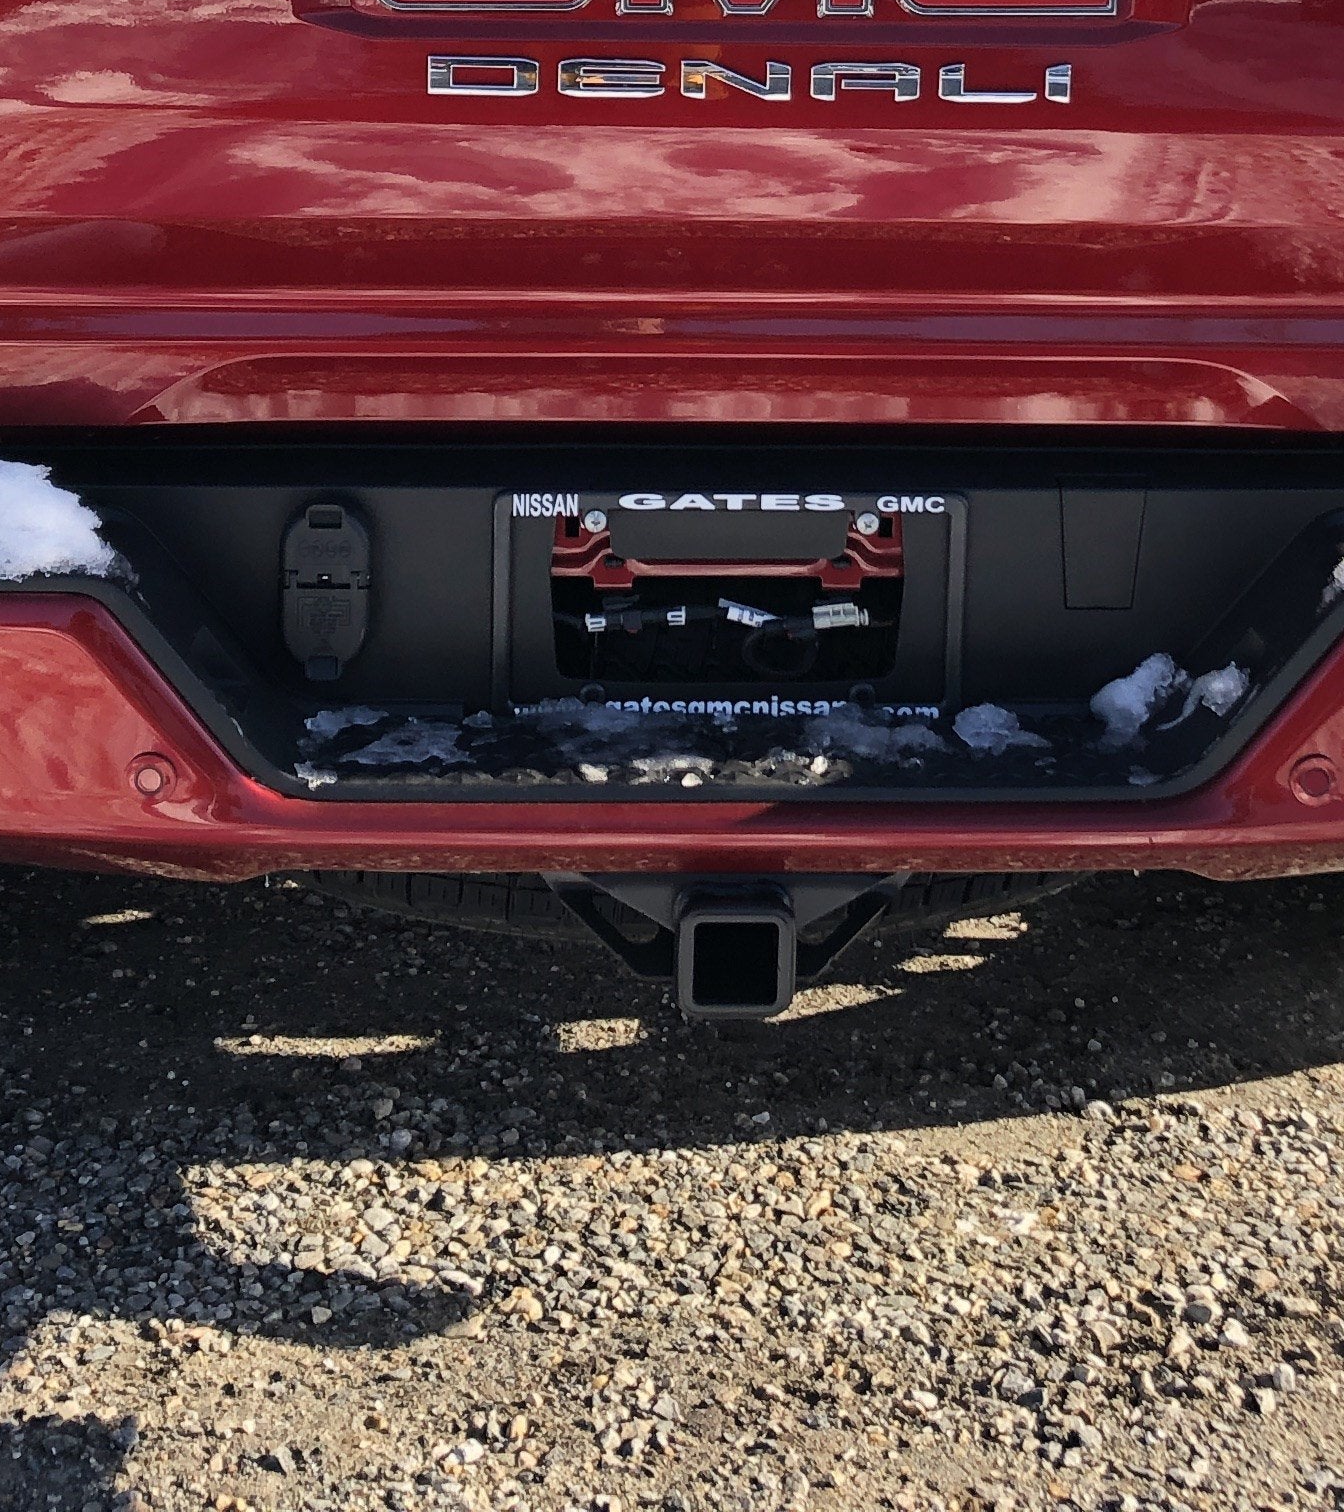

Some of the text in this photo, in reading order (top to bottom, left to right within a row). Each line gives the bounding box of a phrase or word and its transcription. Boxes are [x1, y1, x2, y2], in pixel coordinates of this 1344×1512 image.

[427, 54, 1072, 104] DENALI
[511, 492, 946, 518] NISSAN GATES GMC
